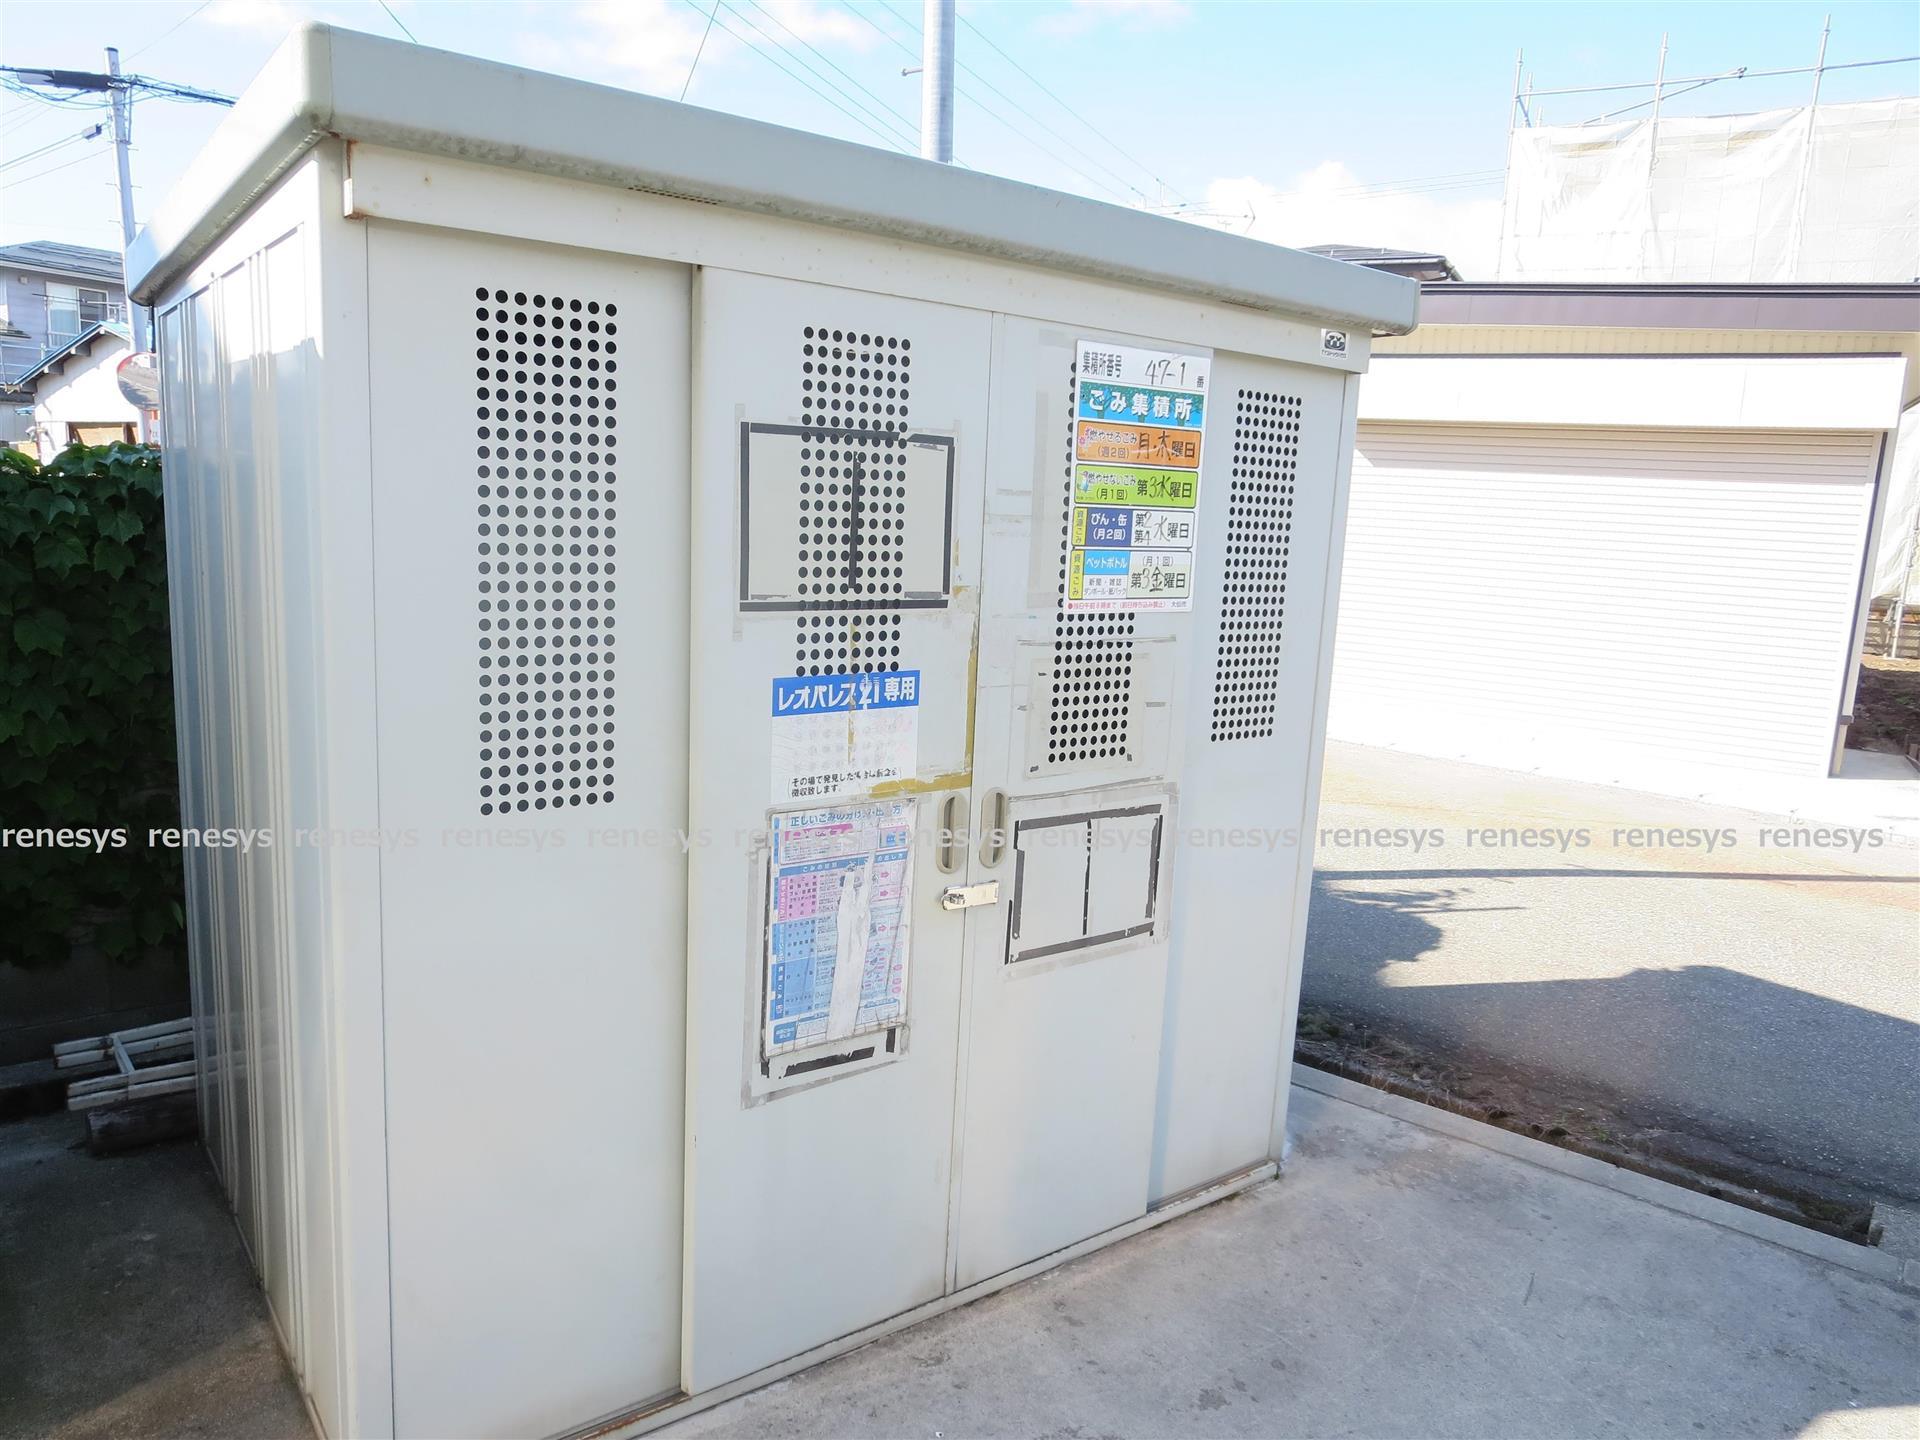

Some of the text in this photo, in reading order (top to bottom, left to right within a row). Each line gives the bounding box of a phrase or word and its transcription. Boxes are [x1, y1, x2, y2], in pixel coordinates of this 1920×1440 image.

[1145, 359, 1187, 386] 47-1
[1089, 389, 1193, 421] ごみ集積所
[1096, 488, 1128, 500] (月1回)
[1090, 512, 1128, 526] びん・缶
[1093, 528, 1126, 540] (月2回)
[1086, 557, 1128, 569] ペットボトル
[1130, 566, 1186, 592] 第3金曜日
